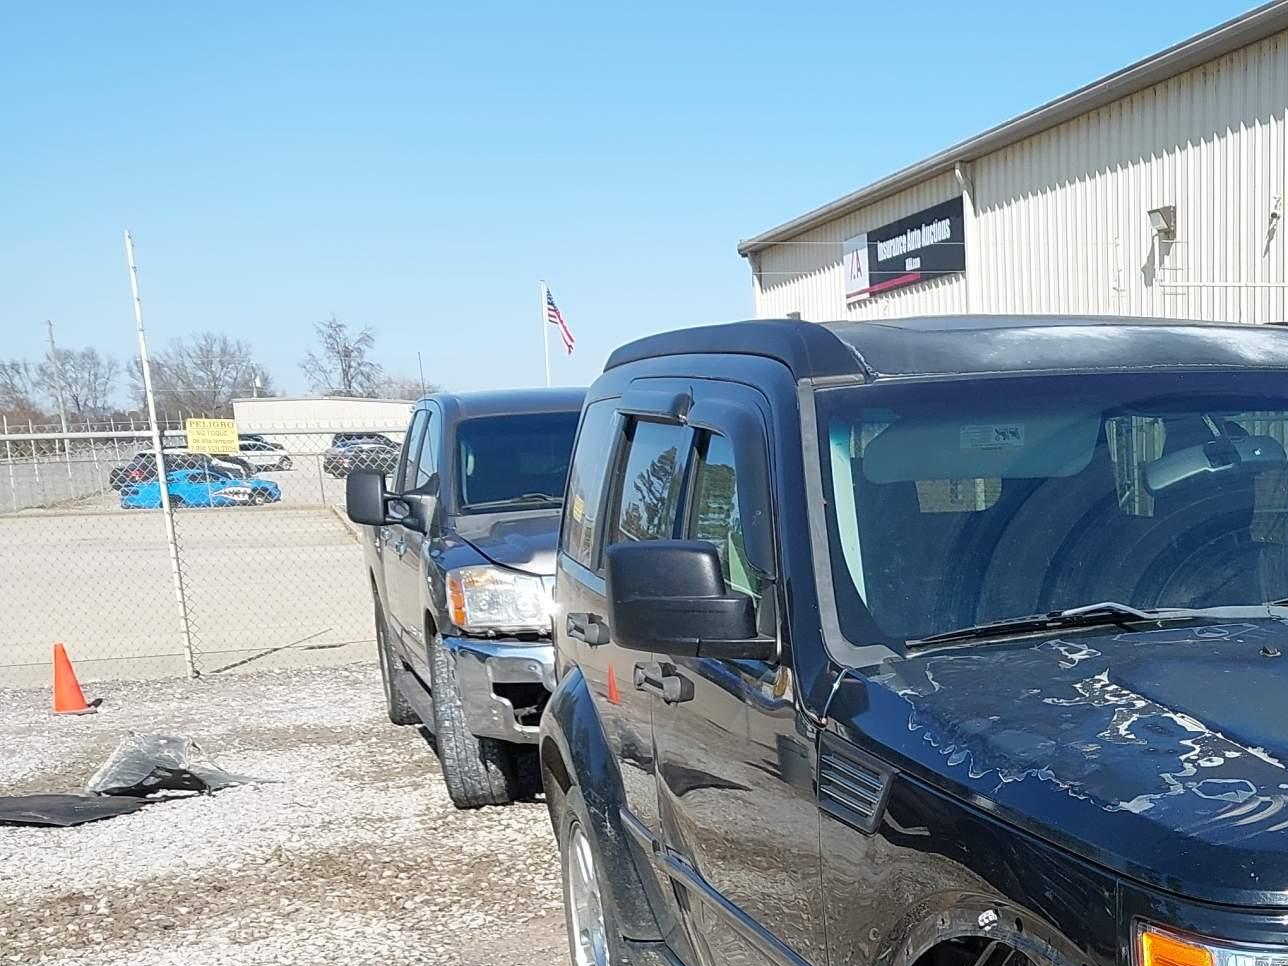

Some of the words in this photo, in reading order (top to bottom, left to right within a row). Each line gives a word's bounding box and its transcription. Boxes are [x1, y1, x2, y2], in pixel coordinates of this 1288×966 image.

[907, 229, 920, 252] Auto
[922, 218, 951, 246] Auctions
[189, 420, 234, 428] PELIGRO
